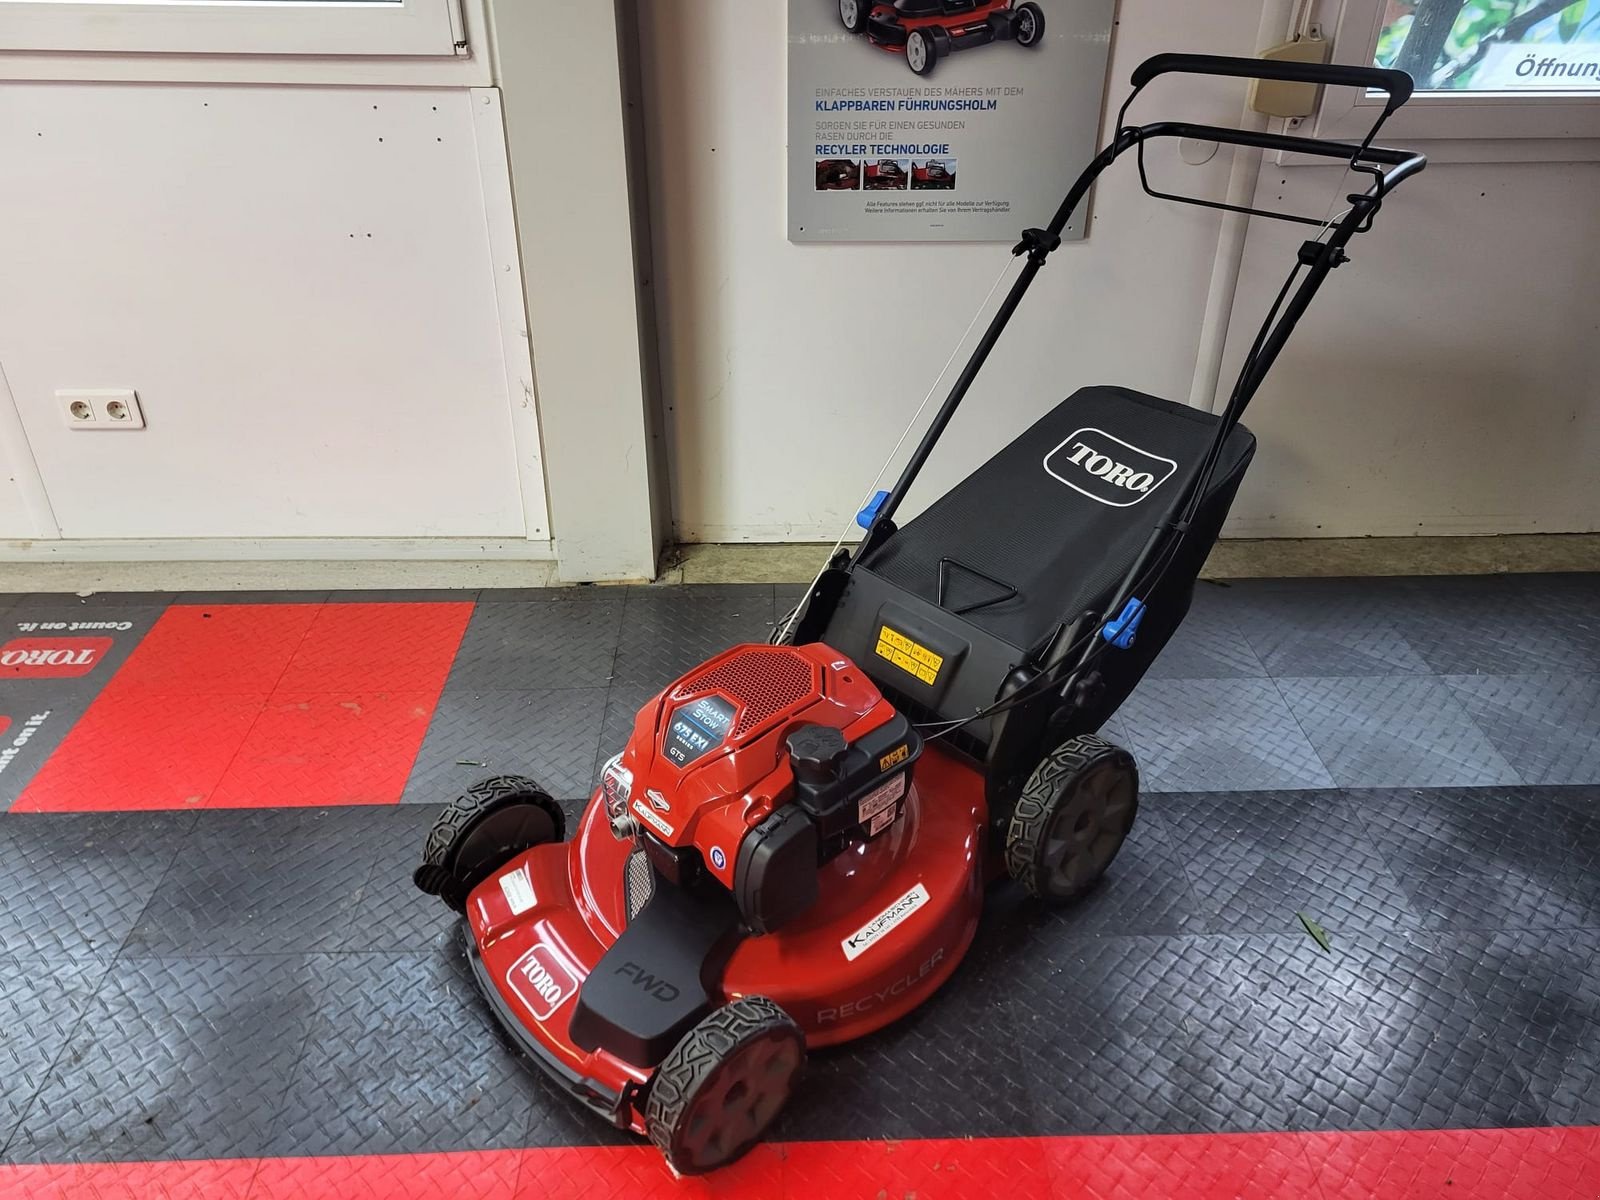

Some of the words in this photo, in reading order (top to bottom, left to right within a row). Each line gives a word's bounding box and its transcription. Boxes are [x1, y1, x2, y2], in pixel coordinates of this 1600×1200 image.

[1515, 53, 1600, 81] Öffnun
[815, 87, 866, 97] EINFACHES
[868, 87, 922, 97] VERSTAUEN
[924, 87, 942, 97] DES
[985, 87, 1002, 96] MIT
[1004, 87, 1024, 96] DEM
[815, 100, 895, 111] KLAPPBAREN
[898, 97, 998, 111] FÜHRUNGSHOLM
[815, 121, 850, 130] SORGEN
[853, 121, 867, 130] SIE
[888, 121, 915, 130] EINEN
[917, 121, 966, 130] GESUNDEN
[815, 132, 845, 141] RASEN
[847, 132, 877, 141] DURCH
[879, 132, 893, 140] DIE
[815, 144, 867, 155] RECYLER
[869, 144, 950, 155] TECHNOLOGIE
[1066, 442, 1154, 492] TORO
[40, 621, 67, 630] on
[69, 621, 133, 631] Count
[0, 649, 96, 666] TORO
[692, 708, 719, 729] STOW
[697, 700, 730, 724] SMART
[13, 728, 37, 746] on
[673, 721, 692, 738] 675
[848, 893, 920, 949] KAUFMANN
[521, 954, 562, 1008] TORO
[614, 961, 681, 1002] FWD
[817, 947, 944, 1024] RECYCLER
